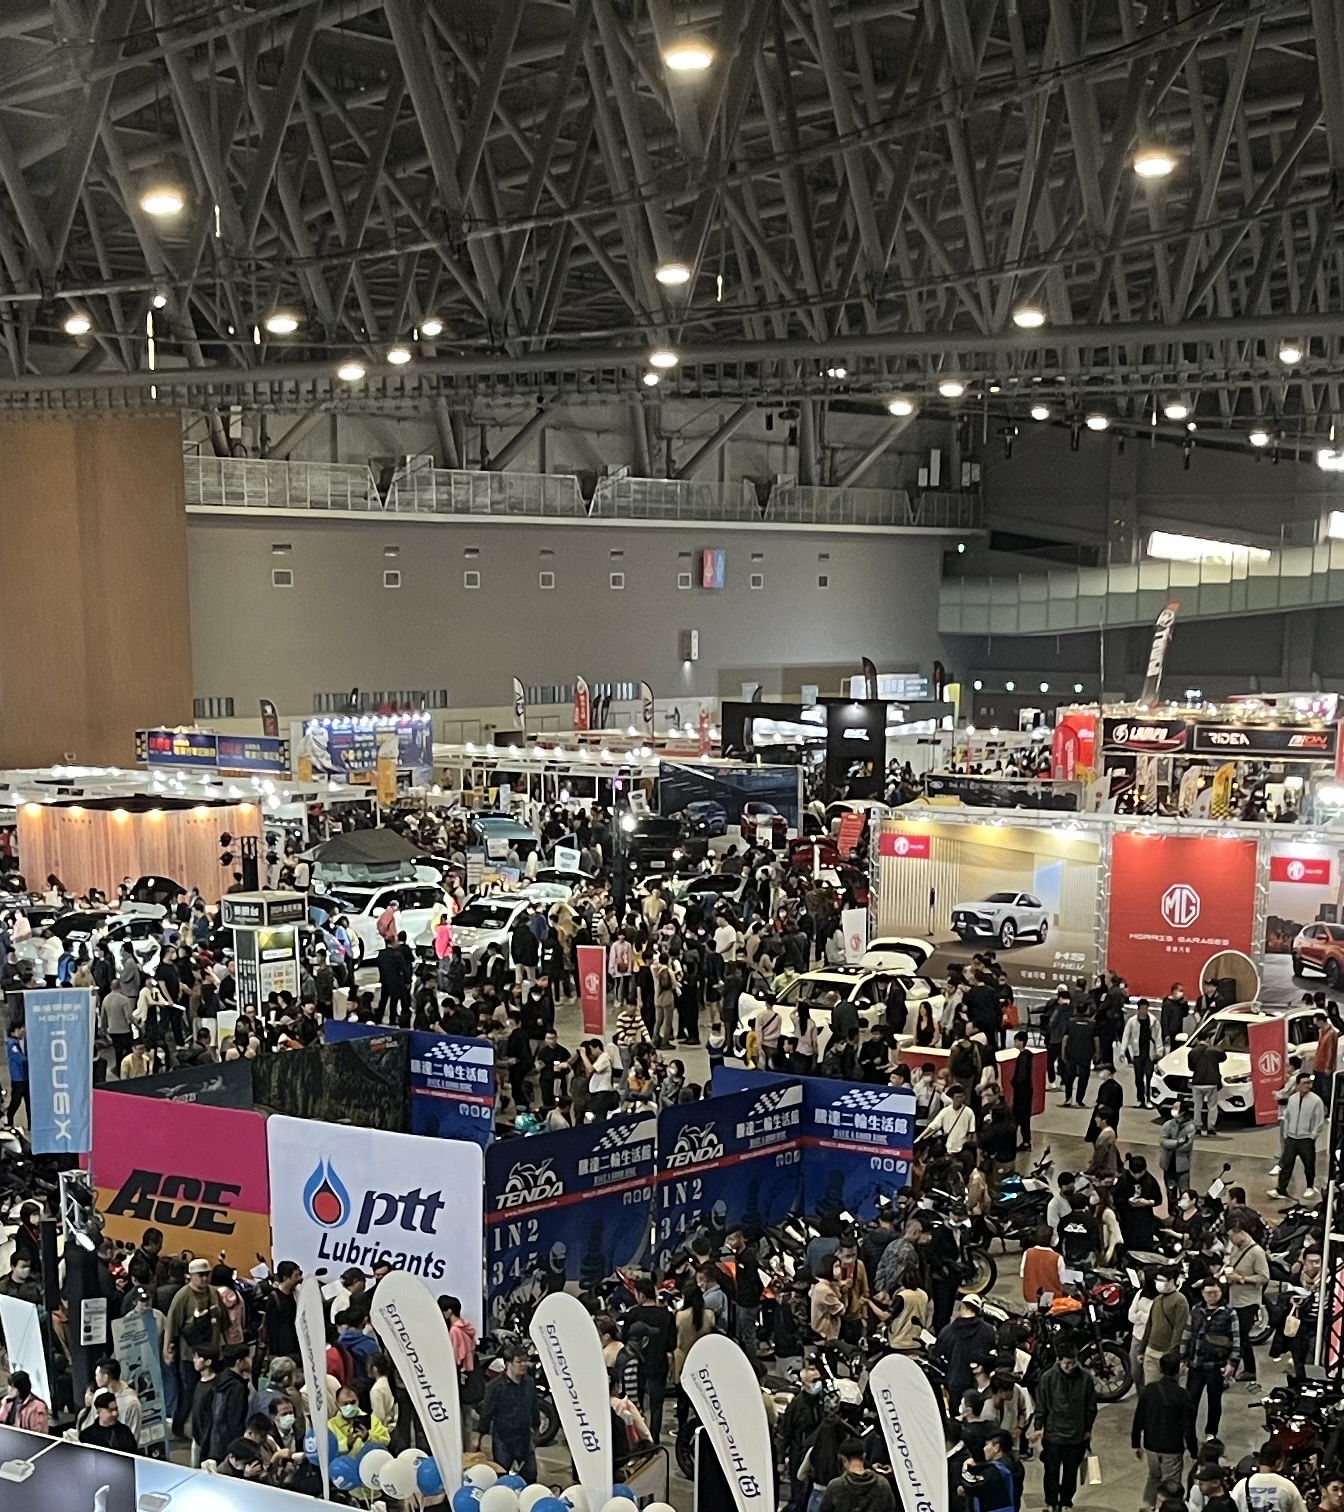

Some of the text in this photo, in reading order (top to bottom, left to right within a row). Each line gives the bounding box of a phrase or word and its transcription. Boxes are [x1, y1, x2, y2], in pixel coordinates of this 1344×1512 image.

[1162, 886, 1200, 927] MG
[665, 1143, 725, 1169] TENDA
[105, 1168, 242, 1235] ACE
[495, 1181, 564, 1210] TENDA
[662, 1178, 703, 1209] 1 N 2
[358, 1187, 446, 1235] ptt
[493, 1218, 539, 1251] 1 N 2
[660, 1217, 671, 1240] 3
[318, 1231, 446, 1282] Lubricants
[492, 1261, 504, 1286] 3
